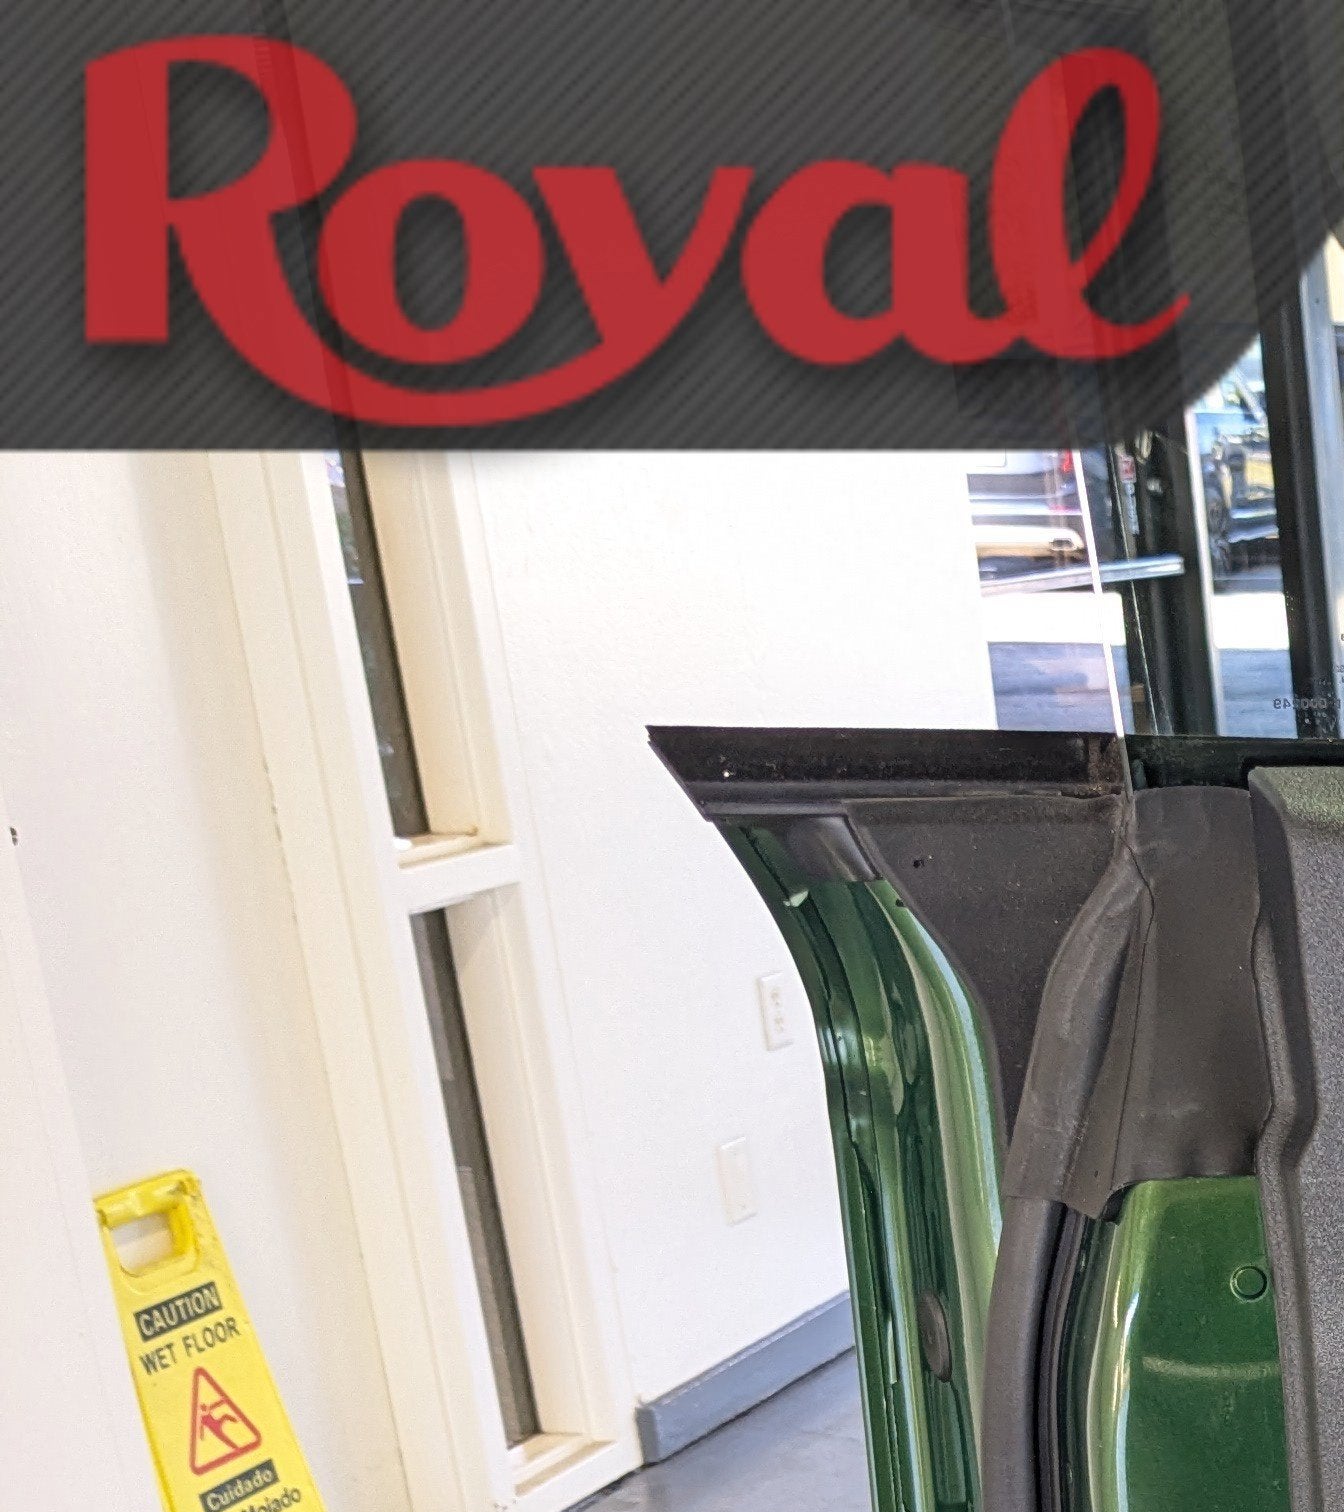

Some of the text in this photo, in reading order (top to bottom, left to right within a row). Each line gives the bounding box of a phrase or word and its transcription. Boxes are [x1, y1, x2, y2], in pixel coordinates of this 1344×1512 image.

[138, 1285, 220, 1337] CAUTION
[139, 1317, 242, 1375] WET FLOOR
[206, 1469, 274, 1512] Cuidado
